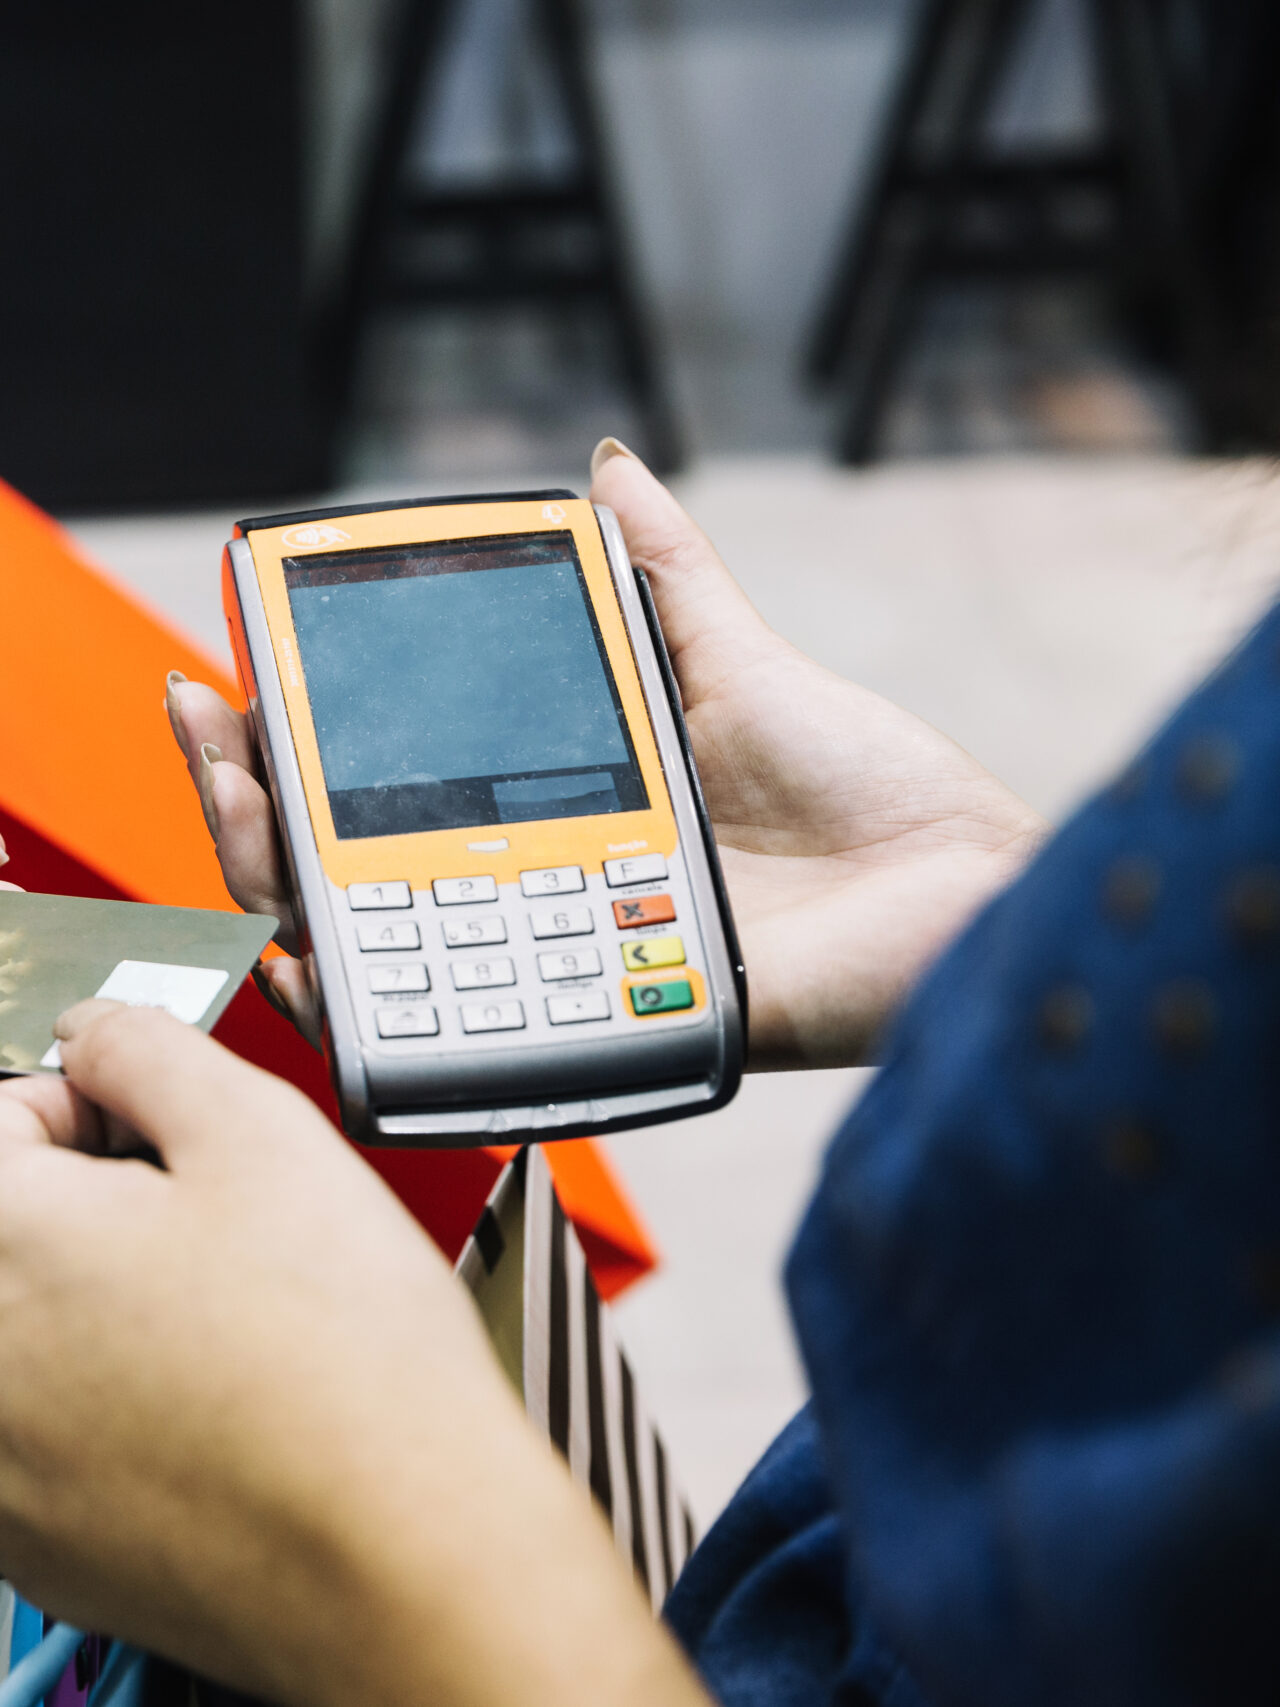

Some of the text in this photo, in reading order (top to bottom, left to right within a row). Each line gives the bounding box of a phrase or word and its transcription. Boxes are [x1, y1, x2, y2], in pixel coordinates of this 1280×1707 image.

[621, 862, 634, 879] F
[543, 872, 560, 889] 3
[372, 887, 384, 902] 1
[459, 881, 474, 898] 2
[553, 912, 570, 930] 6
[379, 926, 395, 942] 4
[467, 921, 484, 939] 5
[475, 963, 492, 981] 8
[561, 954, 578, 973] 9
[386, 968, 402, 985] 7
[483, 1004, 501, 1023] 0
